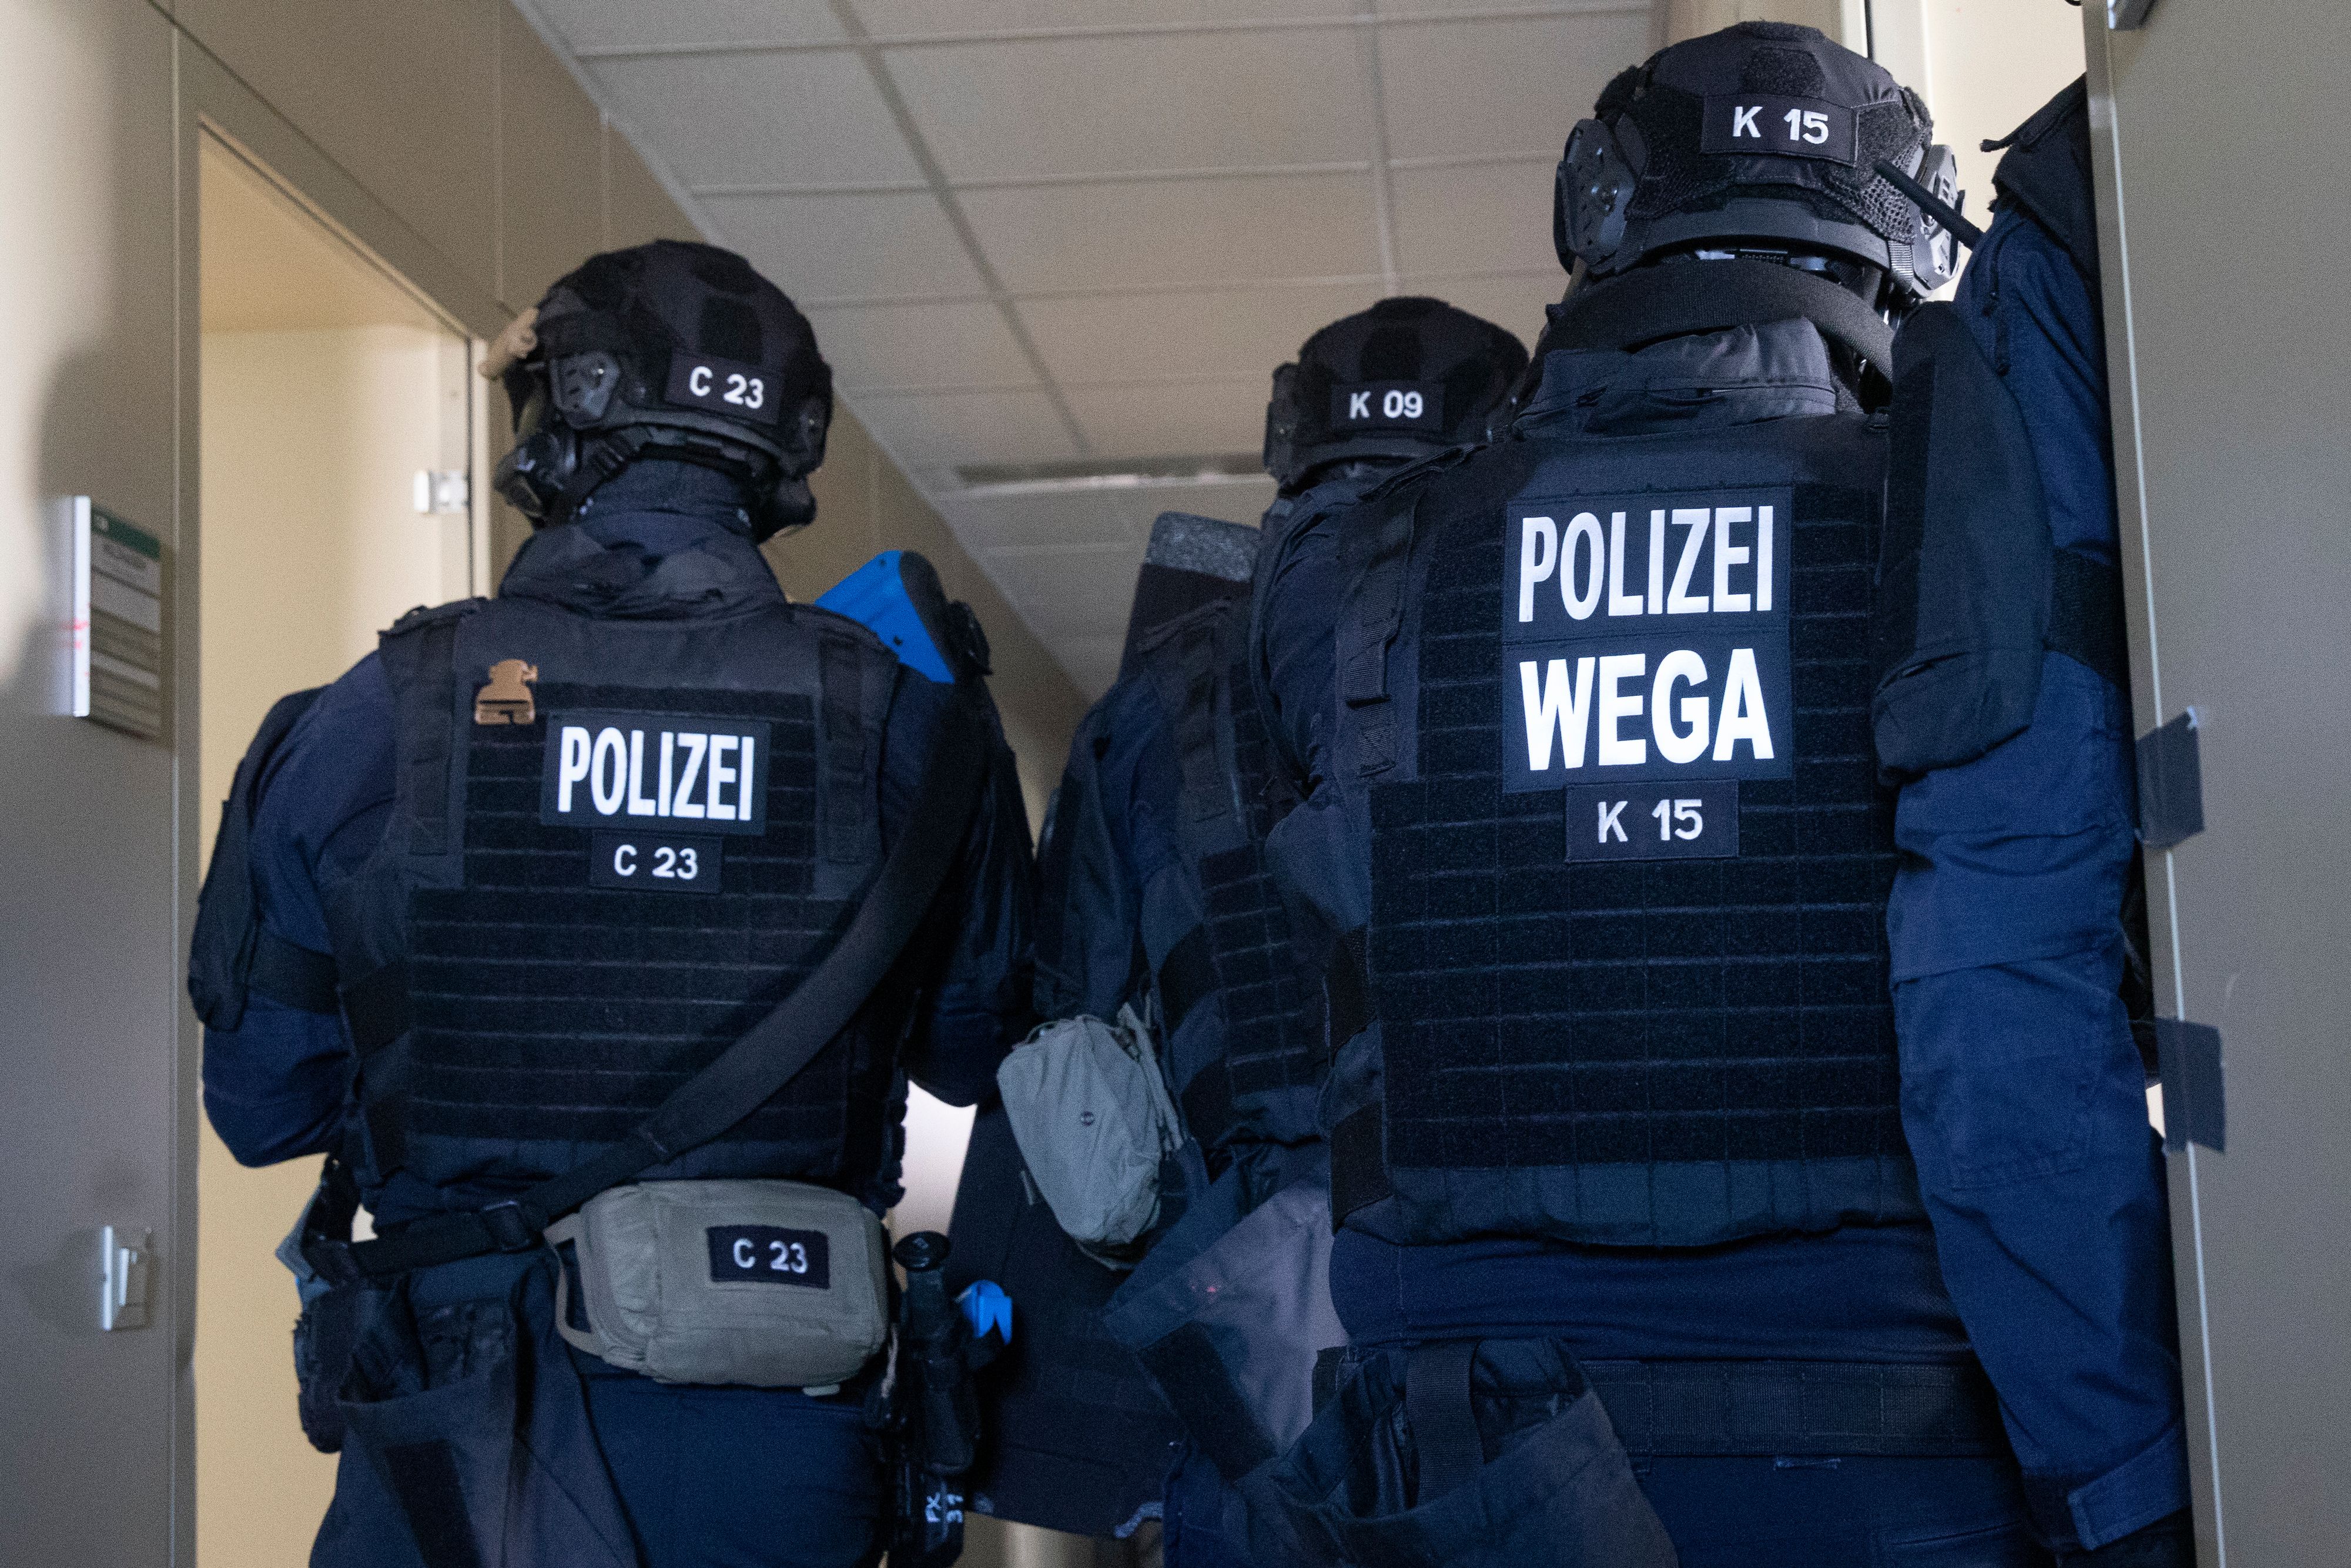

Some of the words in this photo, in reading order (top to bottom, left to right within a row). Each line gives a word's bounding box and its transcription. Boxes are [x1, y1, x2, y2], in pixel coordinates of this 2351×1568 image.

[1733, 106, 1763, 138] K
[1784, 109, 1829, 145] 15
[689, 366, 712, 397] C
[724, 374, 763, 409] 23
[1349, 391, 1371, 419] K
[1383, 390, 1423, 418] 09
[1519, 505, 1773, 622] POLIZEI
[1519, 648, 1774, 771] WEGA
[558, 726, 755, 821] POLIZEI
[1598, 801, 1628, 843] K
[1652, 799, 1703, 841] 15
[614, 844, 637, 876] C
[652, 846, 698, 880] 23
[733, 1238, 755, 1268] C
[769, 1241, 808, 1274] 23
